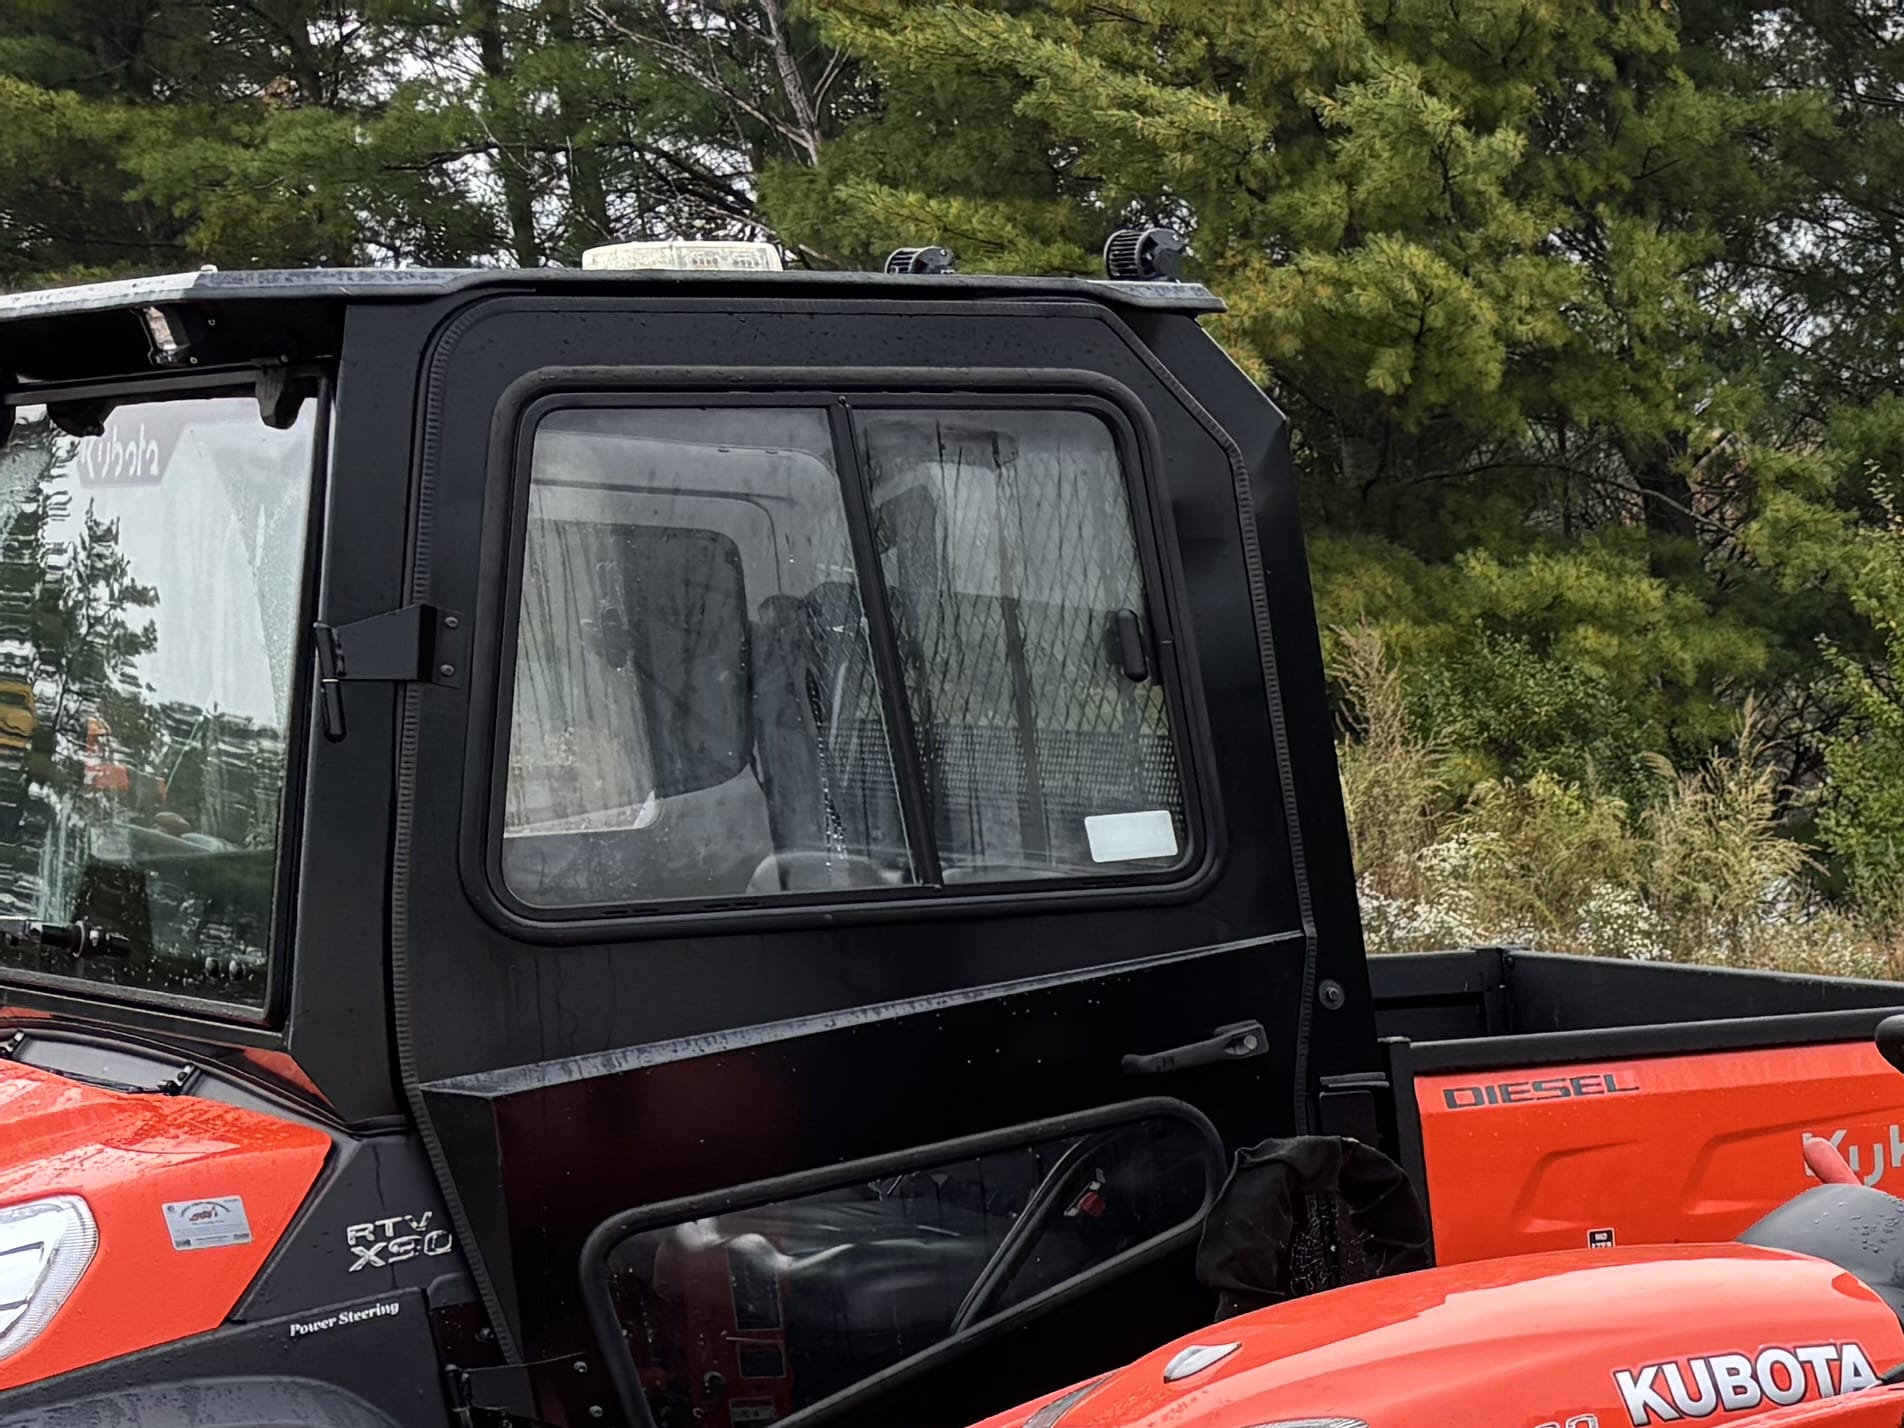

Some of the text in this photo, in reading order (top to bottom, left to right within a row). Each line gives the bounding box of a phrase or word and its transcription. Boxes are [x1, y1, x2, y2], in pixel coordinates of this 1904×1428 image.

[1443, 1074, 1640, 1109] DIESEL
[346, 1211, 433, 1245] RTV
[290, 1301, 400, 1337] Power Steering
[1613, 1343, 1884, 1427] KUBOTA
